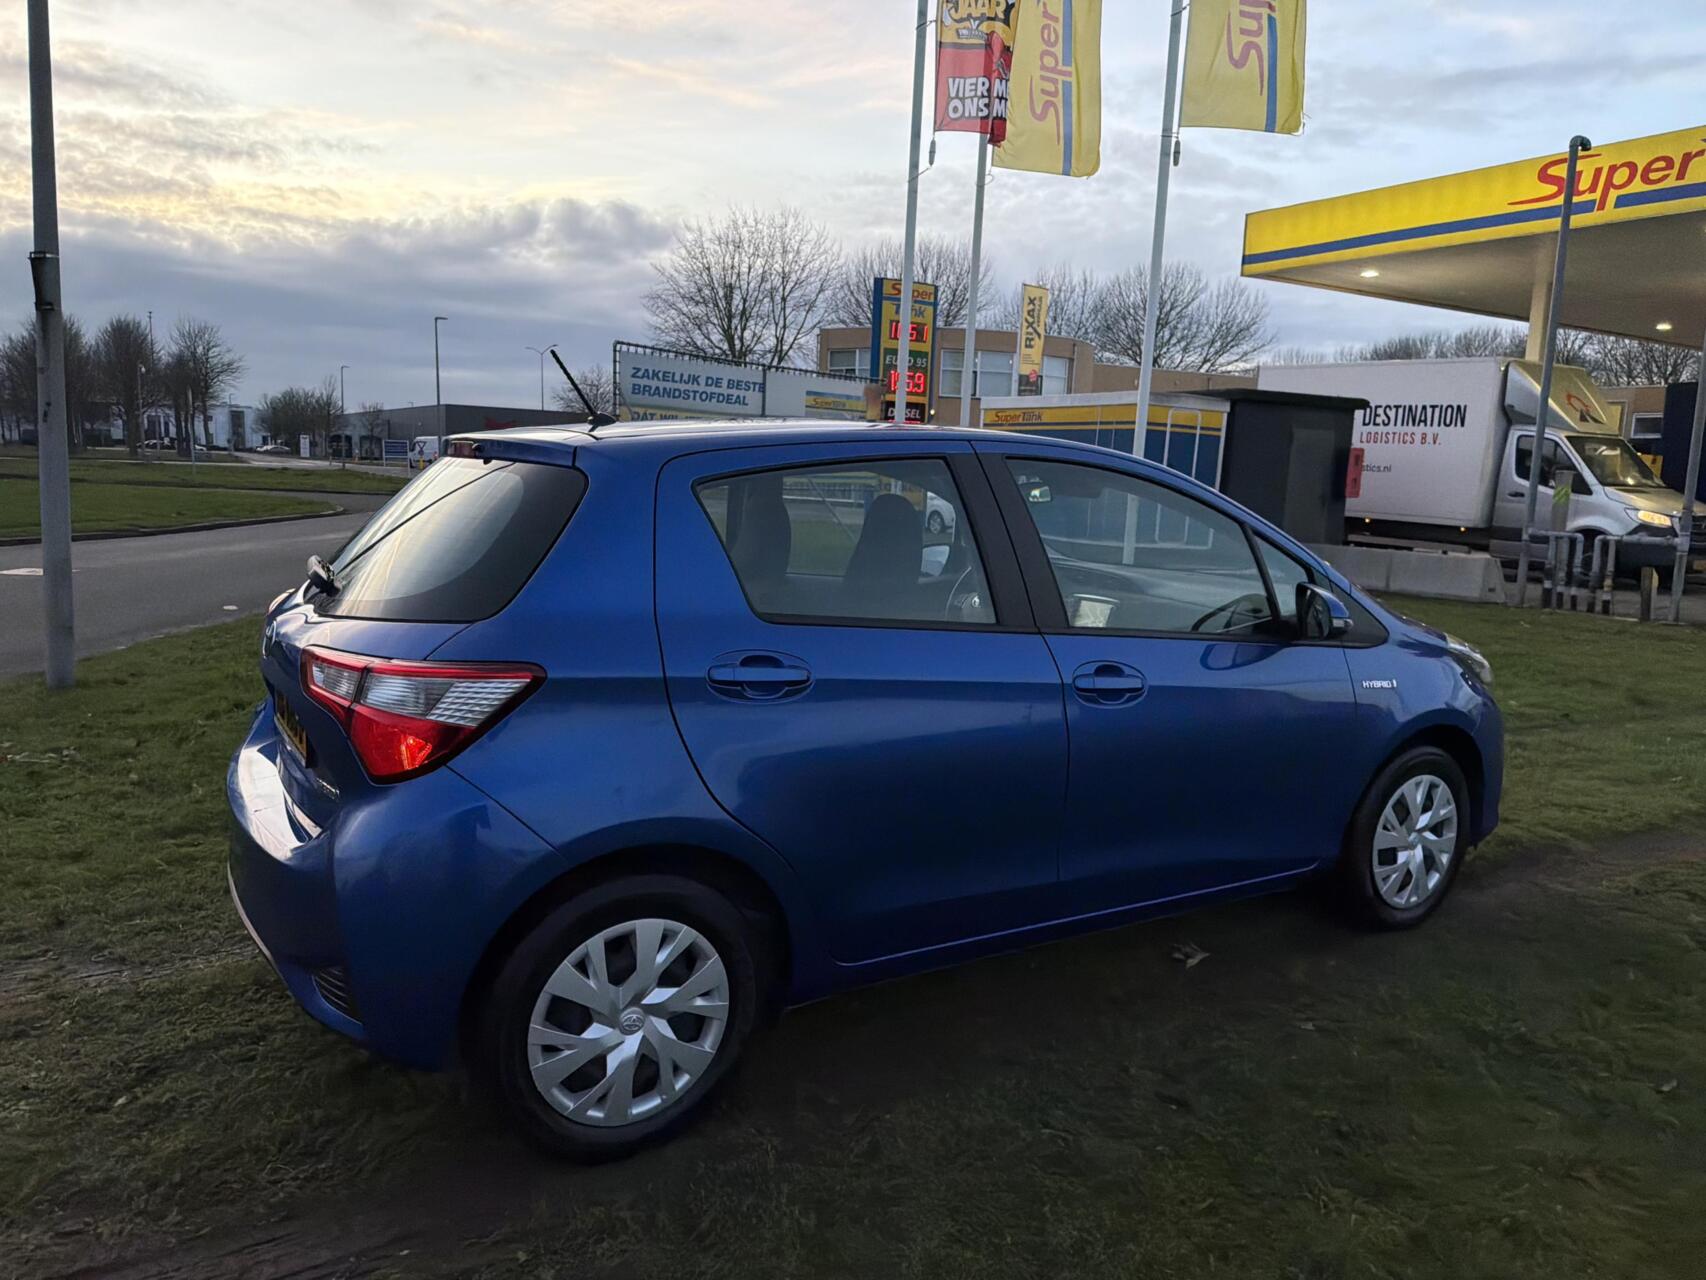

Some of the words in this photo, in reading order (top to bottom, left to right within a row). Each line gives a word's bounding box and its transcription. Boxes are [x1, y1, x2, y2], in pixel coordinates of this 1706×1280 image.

[1029, 0, 1072, 146] Super
[948, 77, 990, 98] VIER
[993, 78, 1009, 98] M
[948, 97, 989, 119] ONS
[1507, 153, 1706, 212] Super
[884, 283, 933, 301] Sper
[885, 355, 913, 367] EUO
[631, 366, 701, 387] ZAKELIJK
[704, 376, 724, 389] DE
[726, 378, 766, 393] BESTE
[631, 383, 749, 406] BRANDSTOFDEAL
[887, 407, 921, 418] DSEL
[1362, 403, 1467, 428] DESTINATION
[1360, 432, 1416, 445] LOGISTICS
[1420, 432, 1443, 446] B.V.
[1362, 680, 1392, 689] HYBRID
